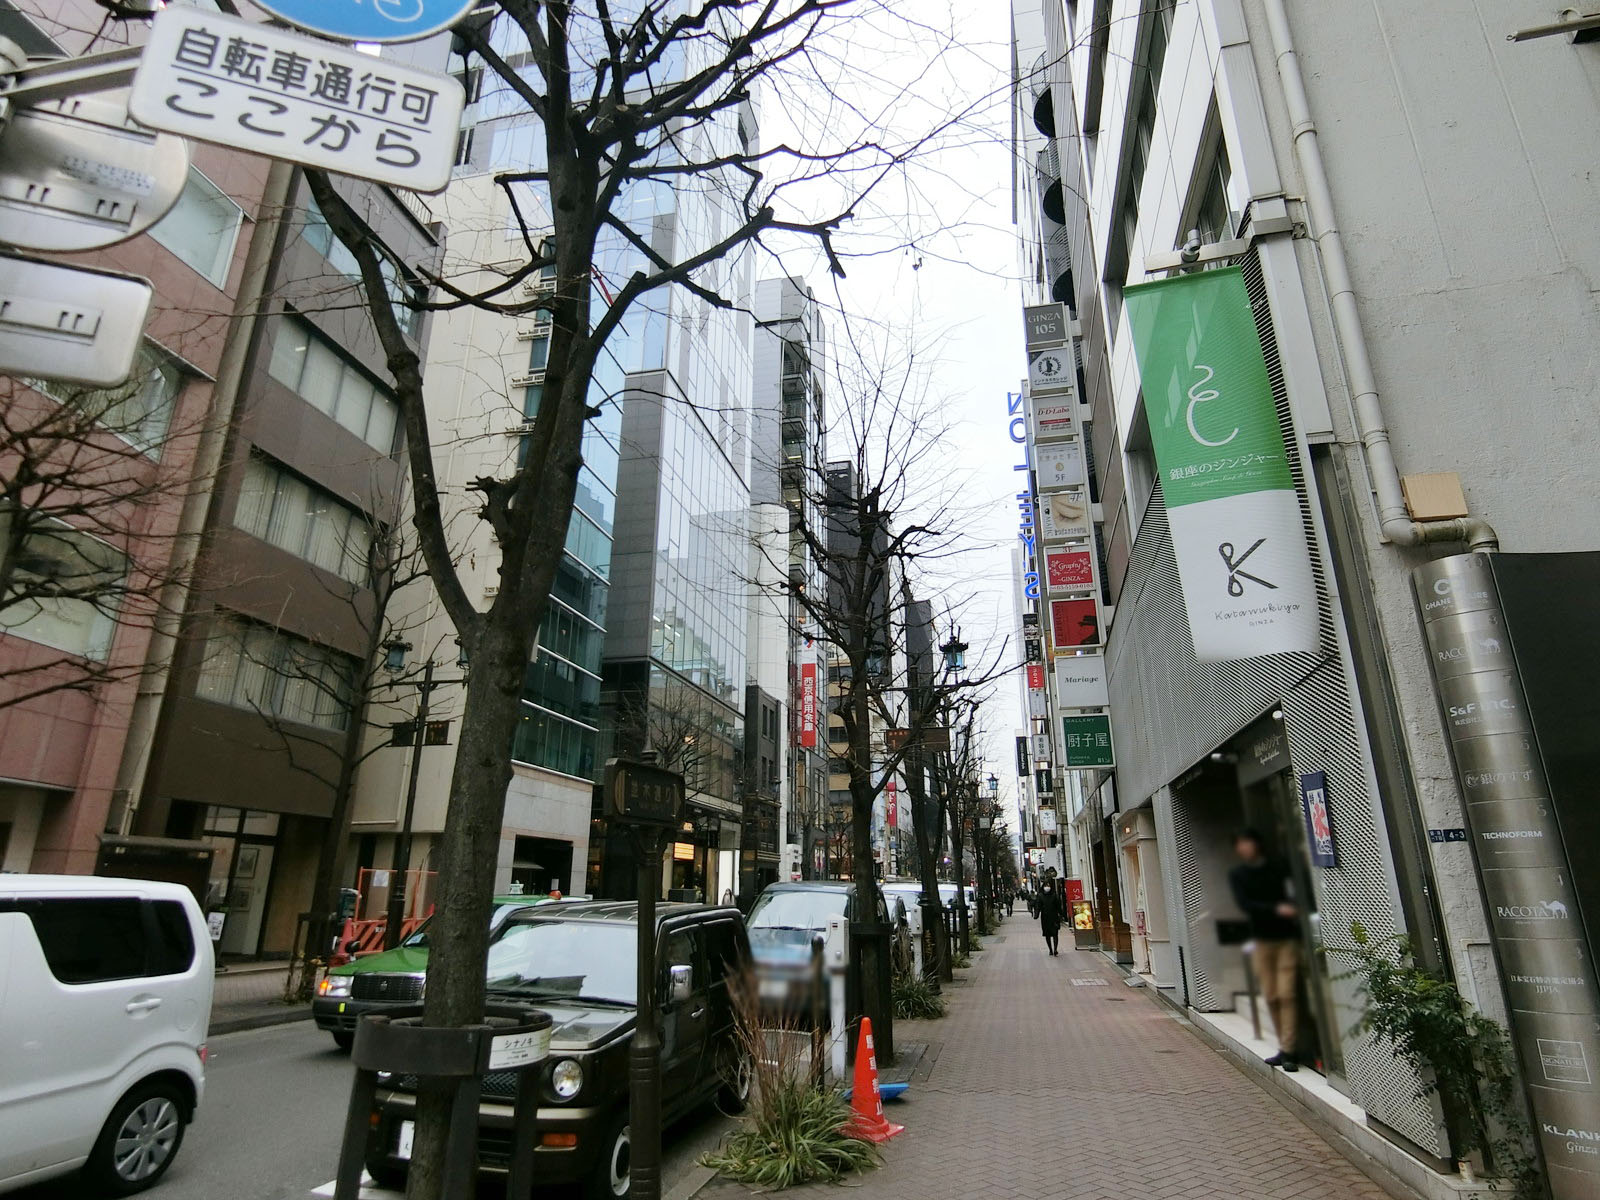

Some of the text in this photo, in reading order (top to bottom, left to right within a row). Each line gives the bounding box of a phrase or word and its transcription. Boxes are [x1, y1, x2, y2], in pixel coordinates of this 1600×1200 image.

[175, 27, 439, 124] 自転車通行可
[166, 78, 421, 168] ここから
[1028, 312, 1061, 323] GINZA
[1034, 323, 1056, 335] 105
[1170, 453, 1279, 480] 銀座のジンジャー
[1449, 703, 1475, 717] S&F
[1067, 732, 1110, 748] 厨子屋
[1449, 831, 1465, 839] 4-3
[1482, 830, 1543, 840] TECHNOFORM
[1497, 906, 1549, 917] RACOTA
[1566, 1141, 1598, 1155] Ginza
